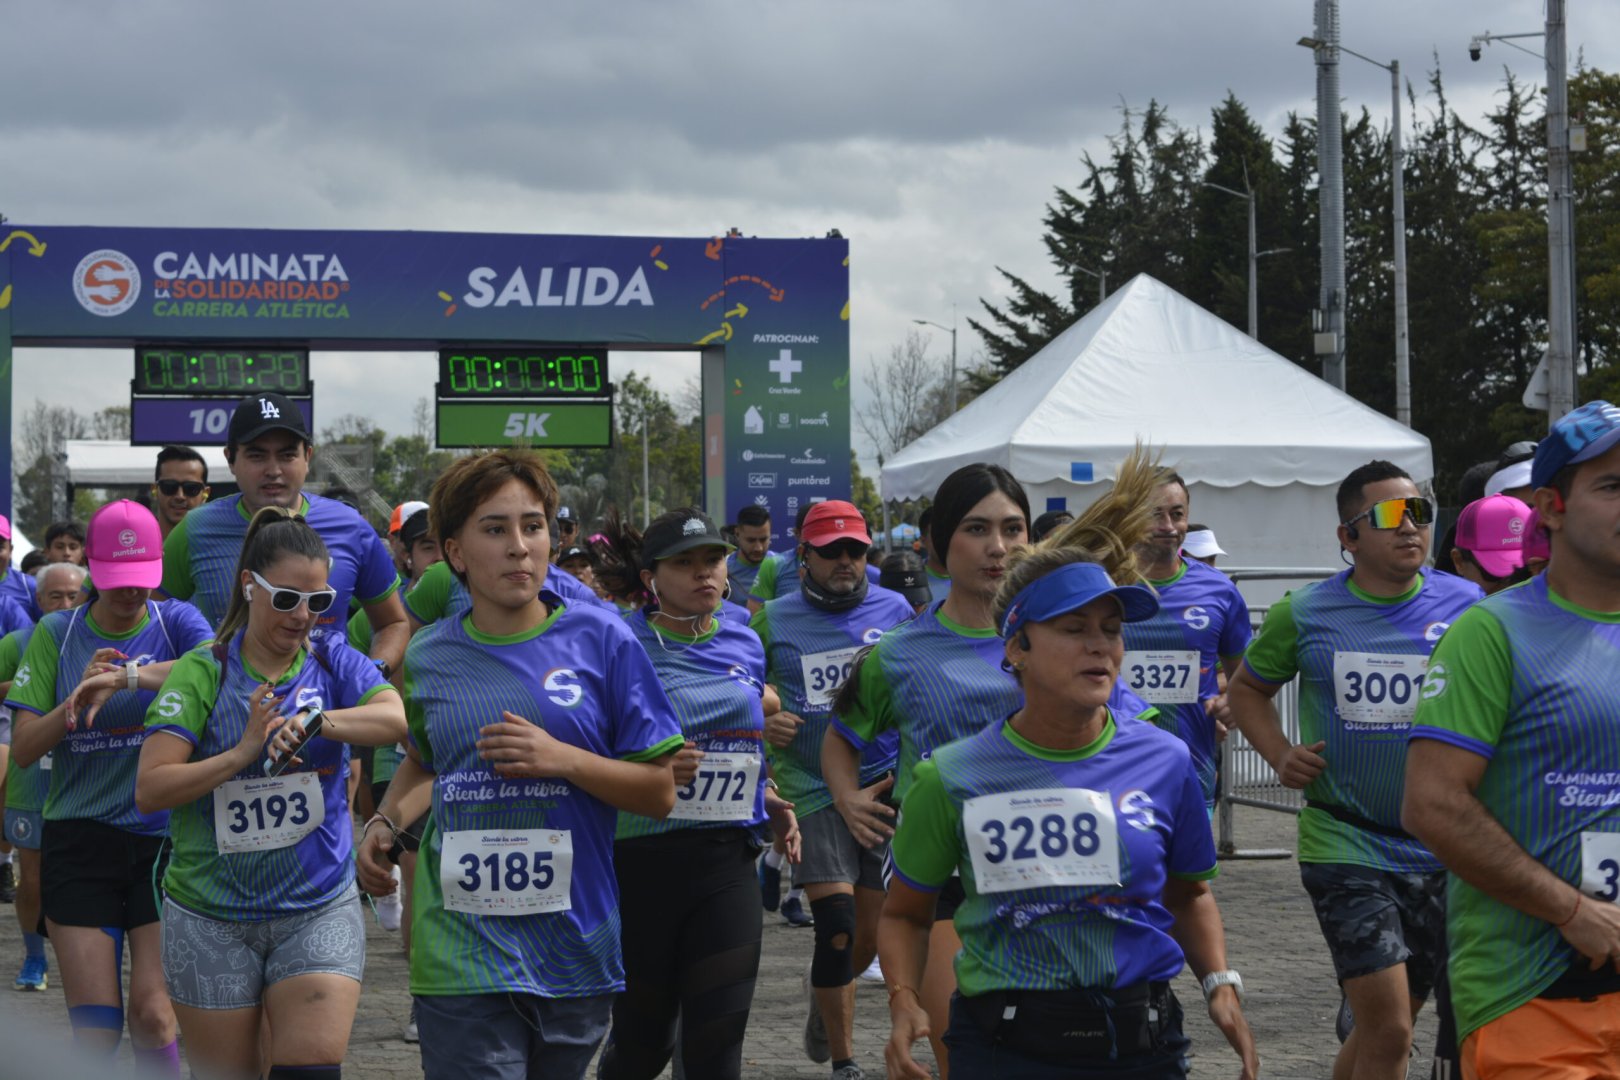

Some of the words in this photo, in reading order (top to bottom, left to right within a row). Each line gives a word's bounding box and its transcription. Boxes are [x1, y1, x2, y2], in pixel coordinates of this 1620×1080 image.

[153, 251, 349, 281] CAMINATA
[154, 289, 171, 299] LA
[155, 280, 170, 289] DE
[463, 265, 655, 308] SALIDA
[153, 300, 248, 318] CARRERA
[255, 298, 350, 319] ATLÉTICA
[753, 333, 820, 344] PATROCINAN:
[143, 351, 301, 390] 00:00:28
[448, 355, 601, 392] 00:00:00
[768, 386, 782, 395] Cruz
[783, 386, 801, 395] Verde
[188, 408, 235, 435] 10
[258, 397, 281, 420] LA
[502, 412, 552, 438] 5K
[1130, 664, 1191, 689] 3327
[1344, 670, 1426, 705] 3001
[70, 739, 106, 753] Siente
[108, 737, 124, 748] la
[708, 739, 725, 751] la
[443, 783, 496, 802] Siente
[499, 782, 521, 798] la
[523, 782, 570, 798] vibra
[677, 770, 746, 801] 3772
[227, 791, 310, 834] 3193
[981, 812, 1100, 864] 3288
[457, 851, 554, 892] 3185
